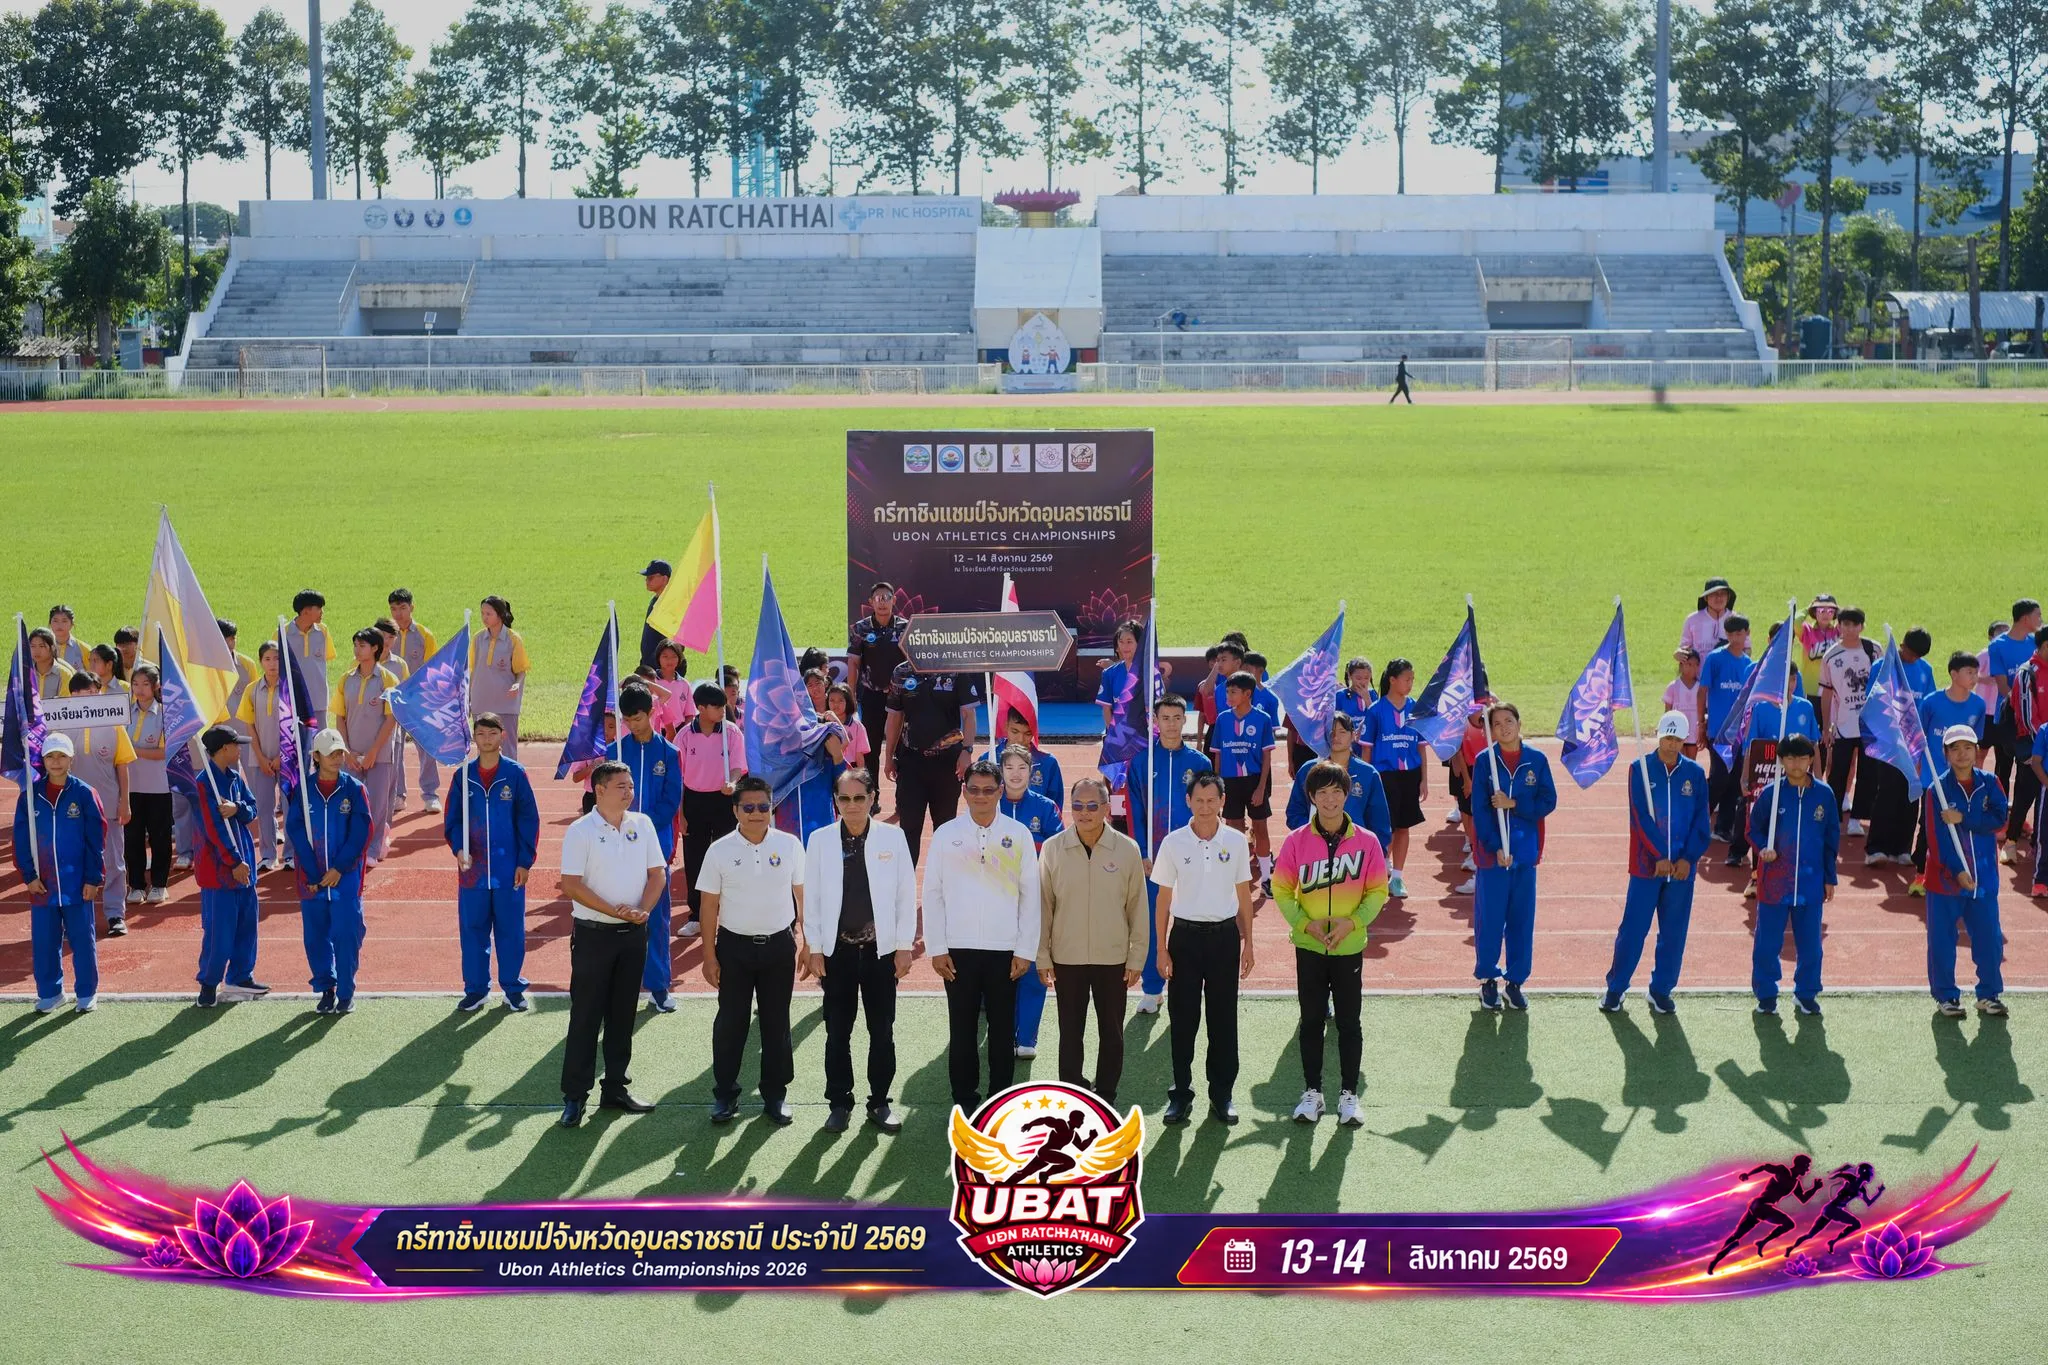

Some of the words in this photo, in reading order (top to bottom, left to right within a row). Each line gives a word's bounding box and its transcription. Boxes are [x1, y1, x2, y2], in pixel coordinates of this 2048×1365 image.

[577, 205, 656, 229] UBON
[912, 206, 973, 218] HOSPITAL
[873, 500, 1132, 528] กรีฑาชิงแชมป์จังหวัดอุบลราชธานี
[892, 532, 930, 541] UBON
[935, 531, 1007, 541] ATHLETICS
[1012, 530, 1116, 541] CHAMPIONSHIPS
[953, 554, 964, 563] 12
[976, 554, 987, 563] 14
[990, 553, 1027, 563] สิงหาคม
[1030, 553, 1053, 563] 2569
[908, 624, 1058, 648] กรีฑาชิงแชมป์จังหวัดอุบลราชธานี
[941, 650, 987, 659] ATHLETICS
[989, 648, 1055, 658] CHAMPIONSHIPS
[43, 706, 124, 721] ขงเจียมวิทยาคม
